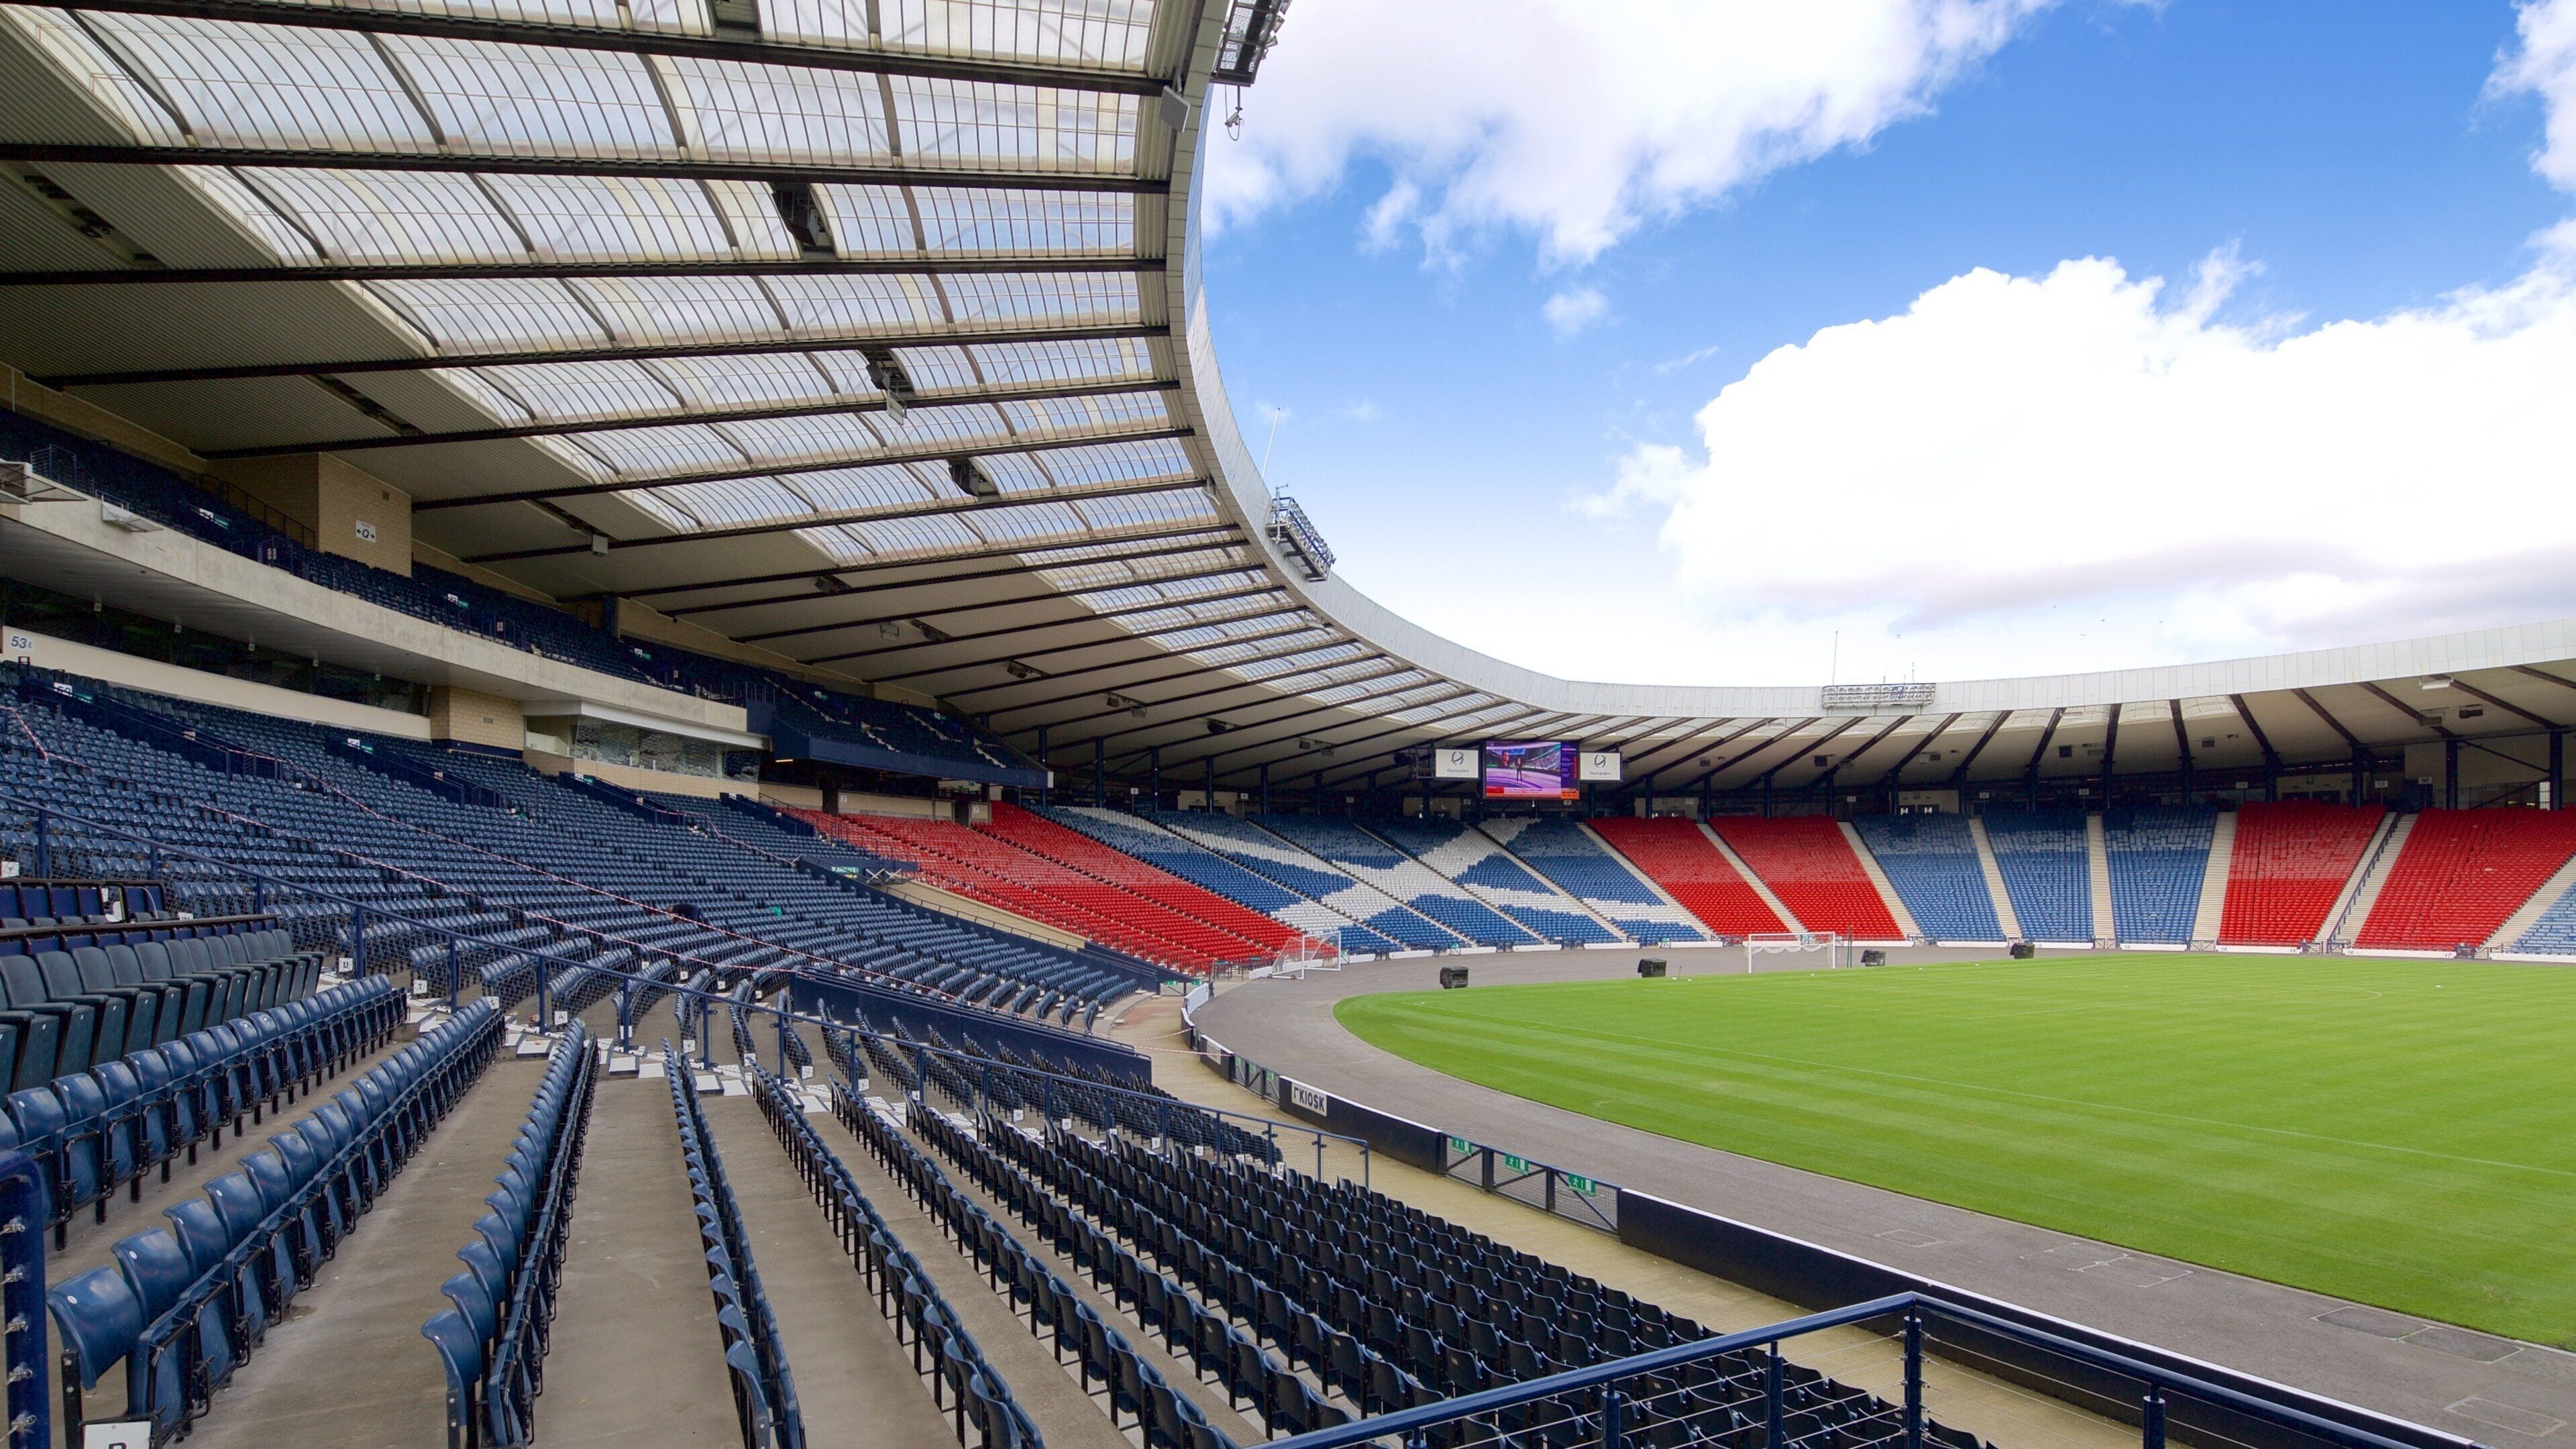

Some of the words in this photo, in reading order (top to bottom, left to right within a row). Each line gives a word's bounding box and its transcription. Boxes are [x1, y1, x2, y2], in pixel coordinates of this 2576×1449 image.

[362, 529, 369, 539] Q
[11, 636, 27, 648] 53
[1299, 1089, 1325, 1112] KIOSK
